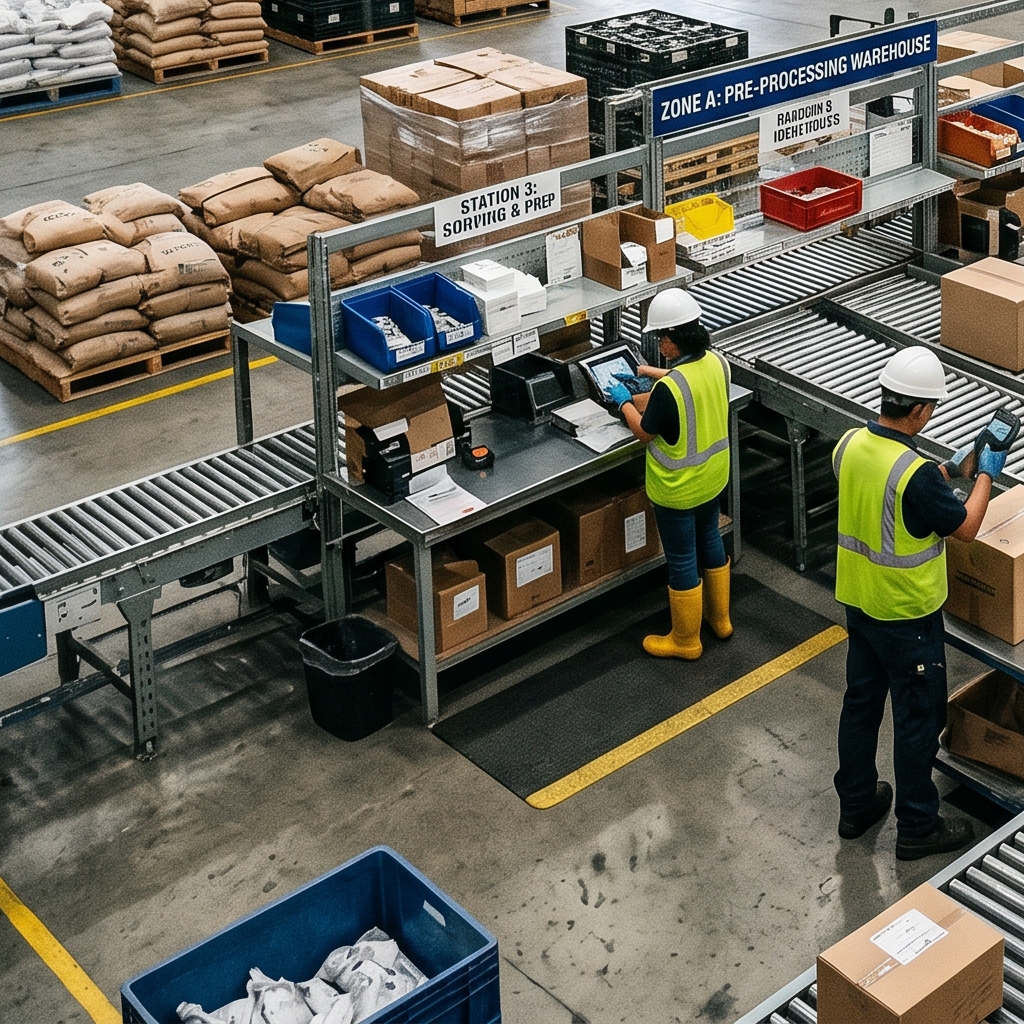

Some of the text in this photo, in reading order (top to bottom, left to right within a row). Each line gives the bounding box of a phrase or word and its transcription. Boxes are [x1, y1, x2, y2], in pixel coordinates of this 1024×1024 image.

[661, 34, 931, 121] ZONE A: PRE-PROCESSING WAREHOUSE
[460, 181, 537, 215] STATION 3:
[511, 203, 520, 218] &
[524, 192, 555, 214] PREP
